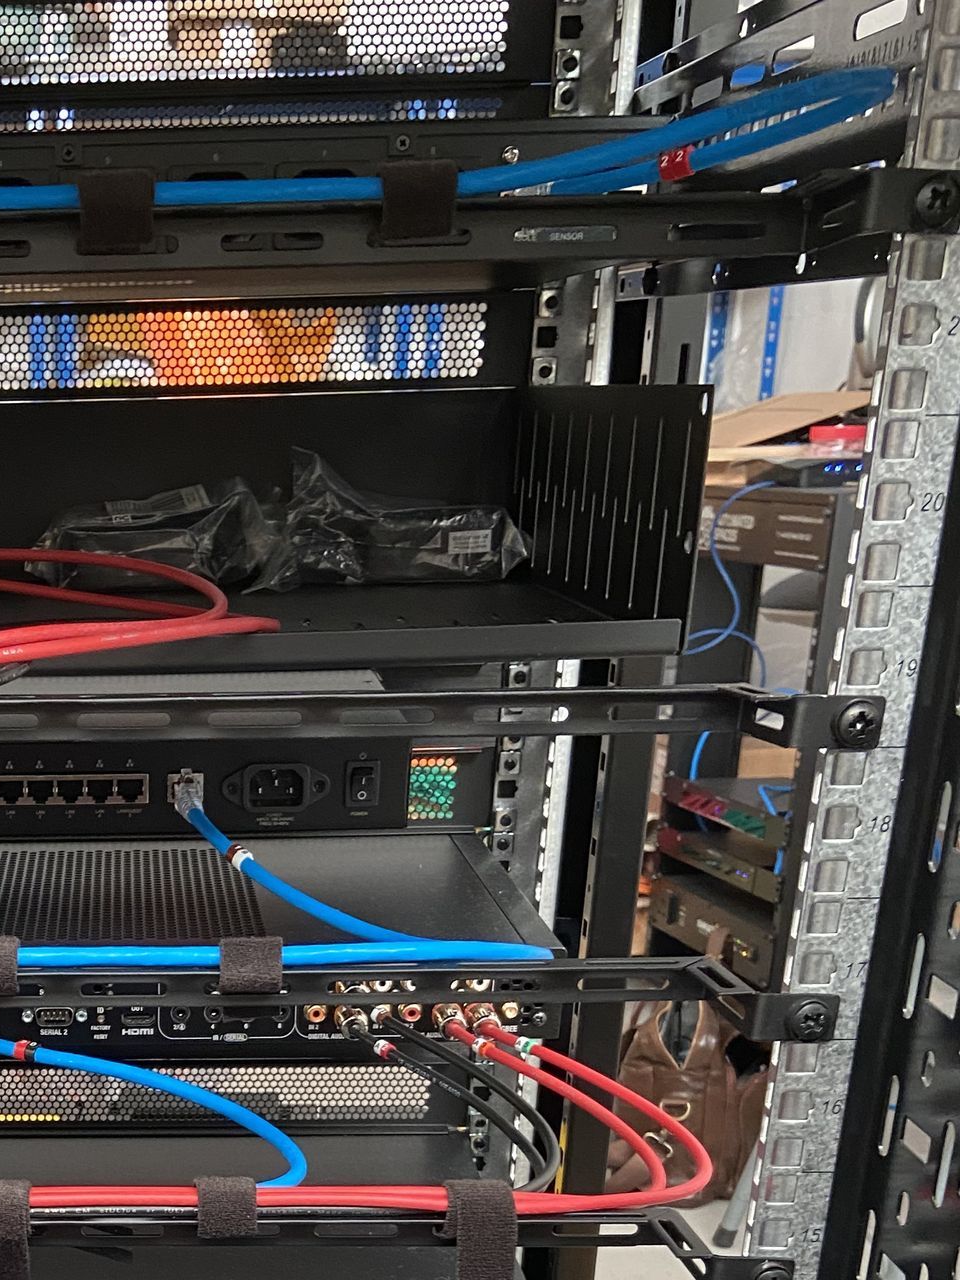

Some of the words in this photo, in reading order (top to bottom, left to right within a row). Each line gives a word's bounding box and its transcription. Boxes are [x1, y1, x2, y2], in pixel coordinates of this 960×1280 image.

[548, 231, 584, 240] SENSOR
[921, 492, 945, 512] 20
[897, 658, 918, 679] 19
[870, 815, 892, 833] 18
[844, 961, 869, 980] 17
[96, 1006, 105, 1014] ID
[40, 1028, 62, 1036] SERIAL
[63, 1028, 69, 1036] 2
[121, 1027, 154, 1036] HDMI
[823, 1099, 842, 1115] 16
[801, 1228, 823, 1243] 15
